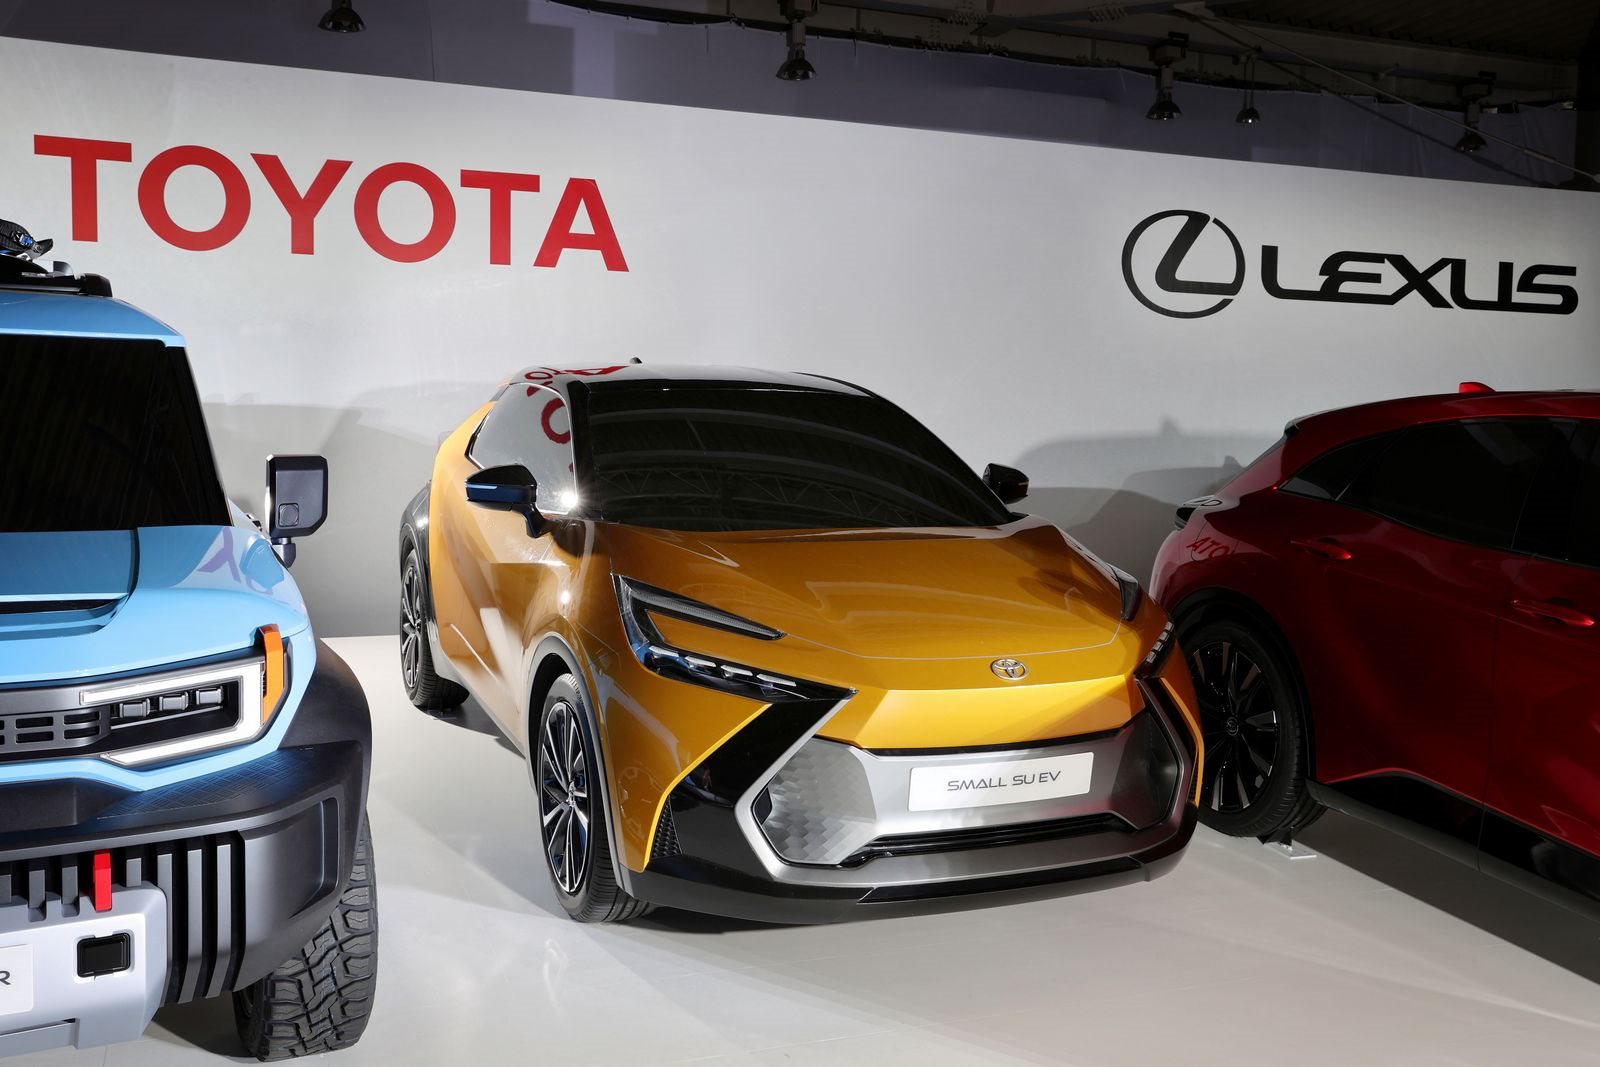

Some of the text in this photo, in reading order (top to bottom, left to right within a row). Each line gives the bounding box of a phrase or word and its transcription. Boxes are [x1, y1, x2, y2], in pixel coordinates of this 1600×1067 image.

[34, 135, 628, 272] TOYOTA
[1260, 244, 1579, 315] LEXUS
[947, 770, 1061, 791] SMALL SU EV
